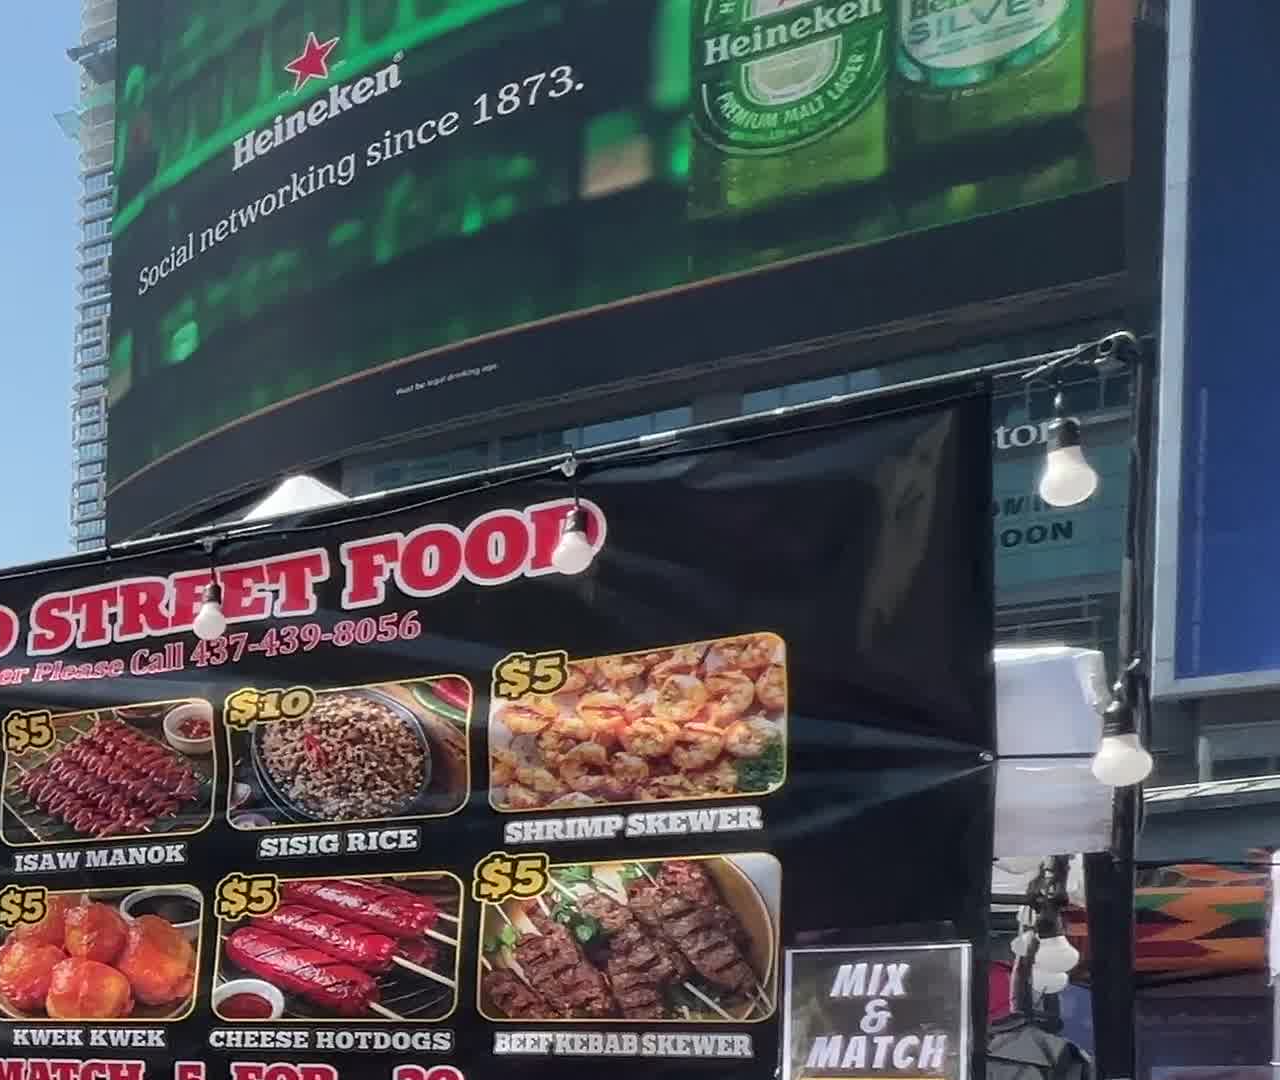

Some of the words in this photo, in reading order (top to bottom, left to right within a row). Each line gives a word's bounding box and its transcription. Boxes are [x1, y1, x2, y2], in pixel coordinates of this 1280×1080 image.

[704, 0, 882, 66] Heineken
[717, 92, 778, 128] PREMIUM
[784, 96, 824, 123] MALT
[827, 52, 865, 100] LAGER
[137, 233, 195, 296] Social
[200, 151, 356, 254] networking
[366, 108, 459, 168] since
[471, 64, 585, 128] 1873.
[1000, 520, 1073, 548] OON
[27, 548, 330, 657] STREET
[341, 498, 607, 609] FOOD
[33, 659, 123, 685] Please
[130, 641, 186, 674] Call
[190, 609, 422, 669] 437-439-8056
[498, 653, 566, 698] $5
[228, 688, 314, 725] $10
[4, 713, 54, 751] $5
[504, 815, 624, 844] SHRIMP
[625, 805, 764, 838] SKEWER
[14, 851, 80, 873] ISAW
[85, 844, 185, 869] MANOK
[259, 833, 340, 859] SISIG
[345, 828, 419, 854] RICE
[217, 876, 278, 918] $5
[478, 856, 549, 901] $5
[830, 963, 911, 999] MIX
[861, 999, 893, 1033] &
[13, 1029, 84, 1048] KWEK
[89, 1029, 166, 1048] KWEK
[209, 1030, 309, 1050] CHEESE
[315, 1030, 453, 1052] HOTDOGS
[493, 1033, 555, 1055] BEEF
[555, 1034, 639, 1055] KEBAB
[641, 1033, 754, 1057] SKEWER
[806, 1034, 947, 1071] MATCH
